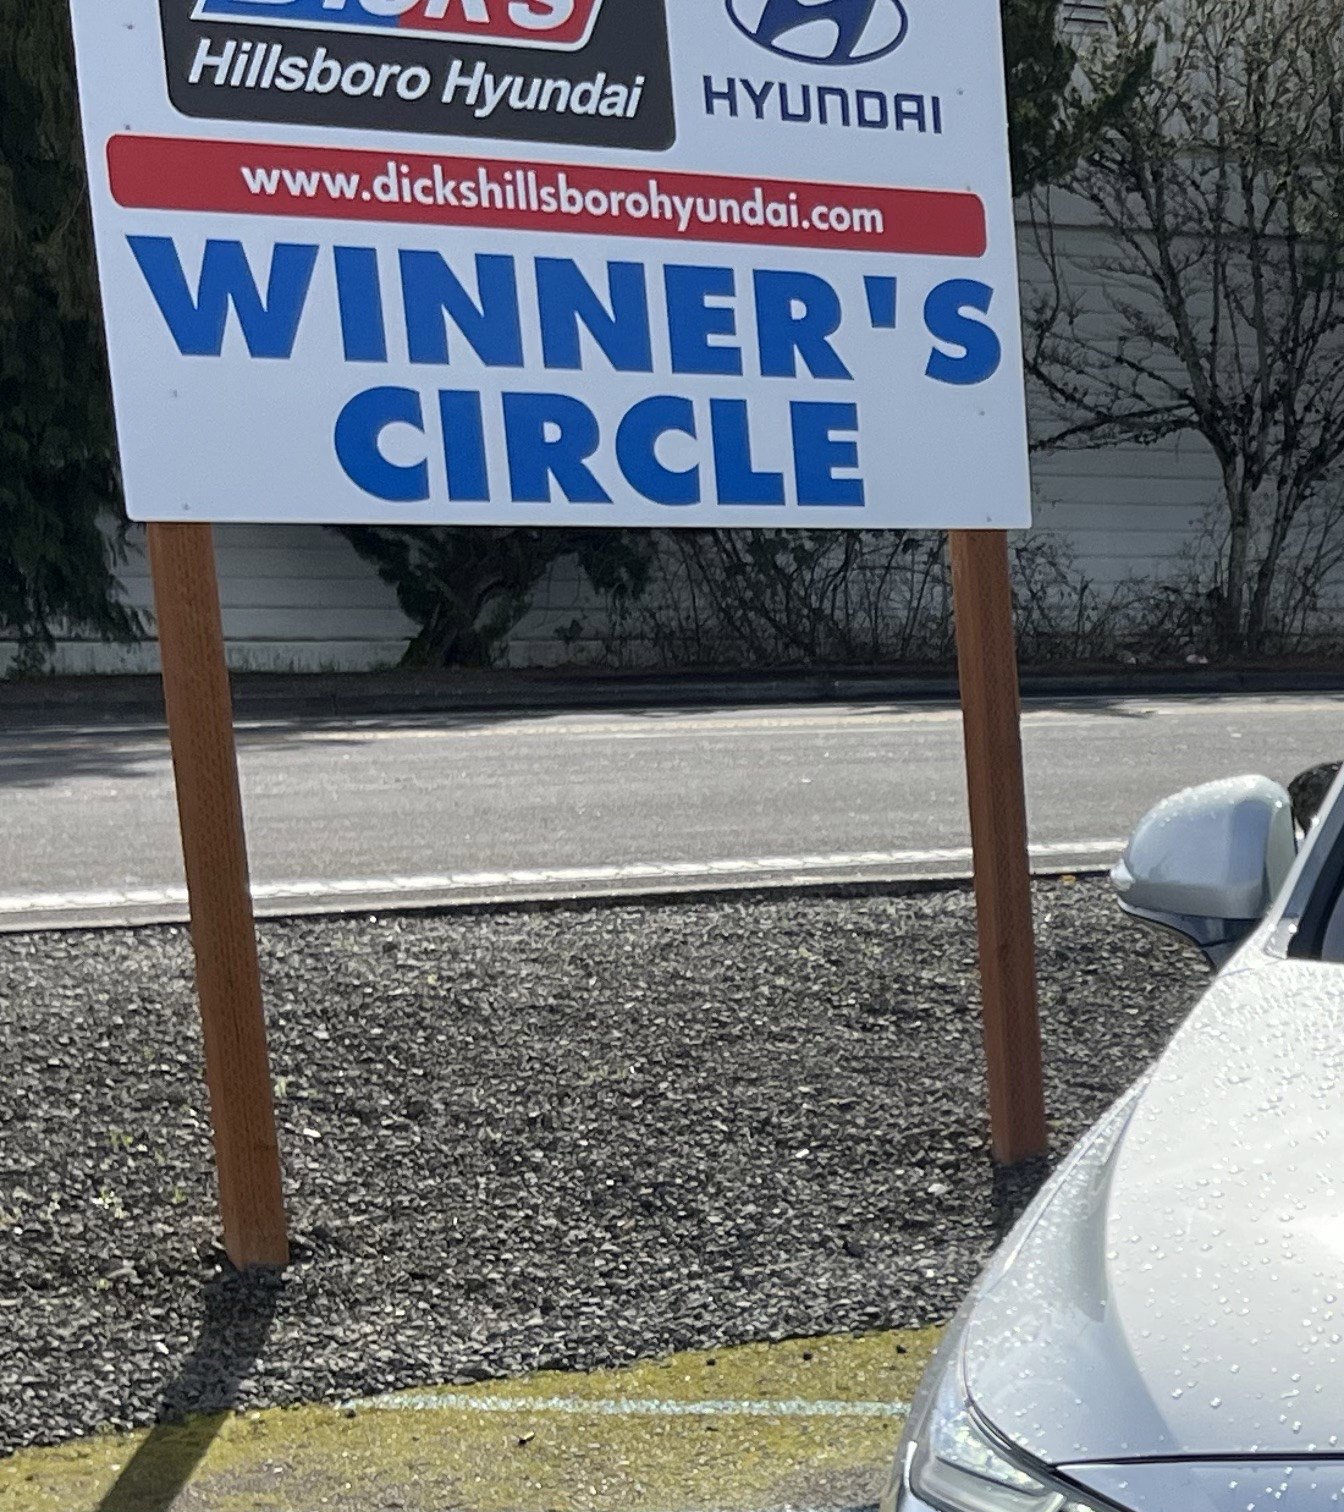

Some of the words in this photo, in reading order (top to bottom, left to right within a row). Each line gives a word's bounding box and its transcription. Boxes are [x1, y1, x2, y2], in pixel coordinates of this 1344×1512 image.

[188, 38, 430, 100] Hillsboro
[441, 59, 646, 119] Hyundai
[703, 74, 943, 135] HYUNDAI
[240, 161, 885, 236] www.dickshillsborohyundai.com
[126, 234, 1001, 386] WINNER'S
[333, 385, 866, 508] CIRCLE
